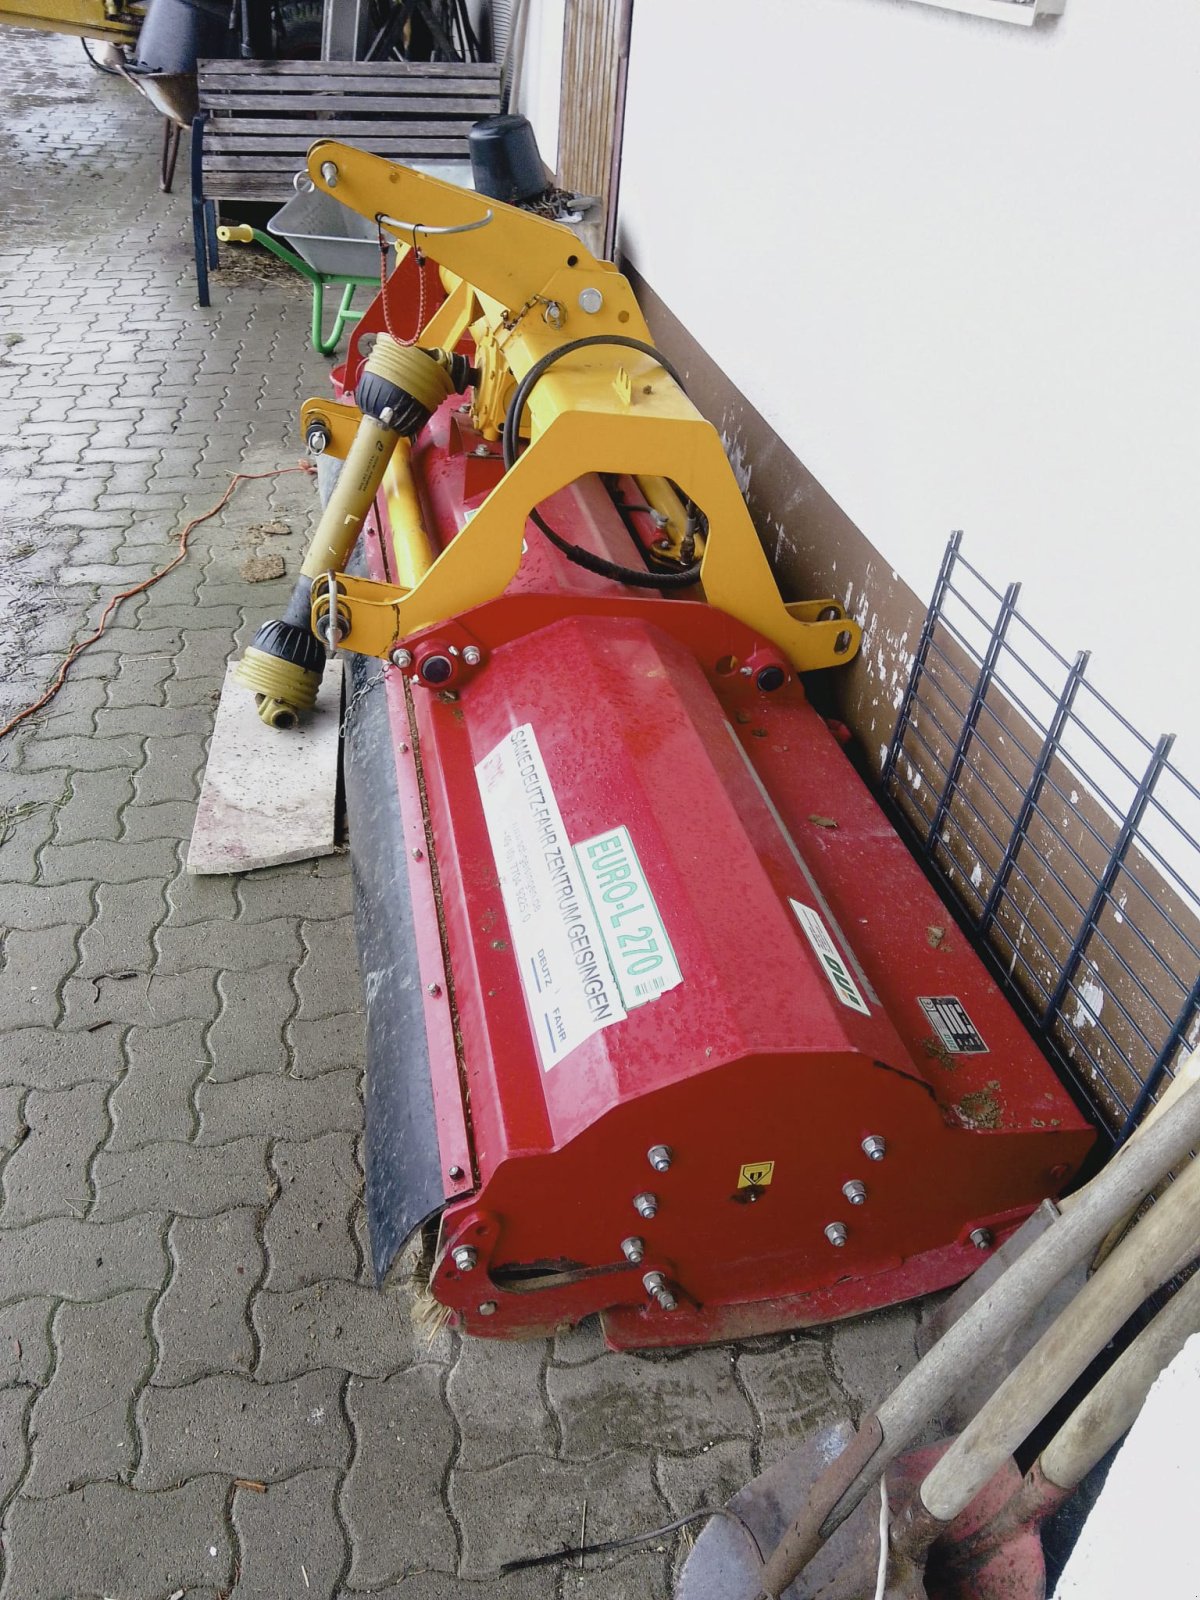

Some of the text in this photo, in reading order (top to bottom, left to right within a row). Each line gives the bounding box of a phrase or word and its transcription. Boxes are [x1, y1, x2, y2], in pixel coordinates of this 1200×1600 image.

[510, 730, 613, 1022] SAME DEUTZ-FAHR ZENTRUM GEISINGEN
[586, 835, 664, 976] EURO-L 270
[536, 948, 567, 1042] DEUTZ FAHR
